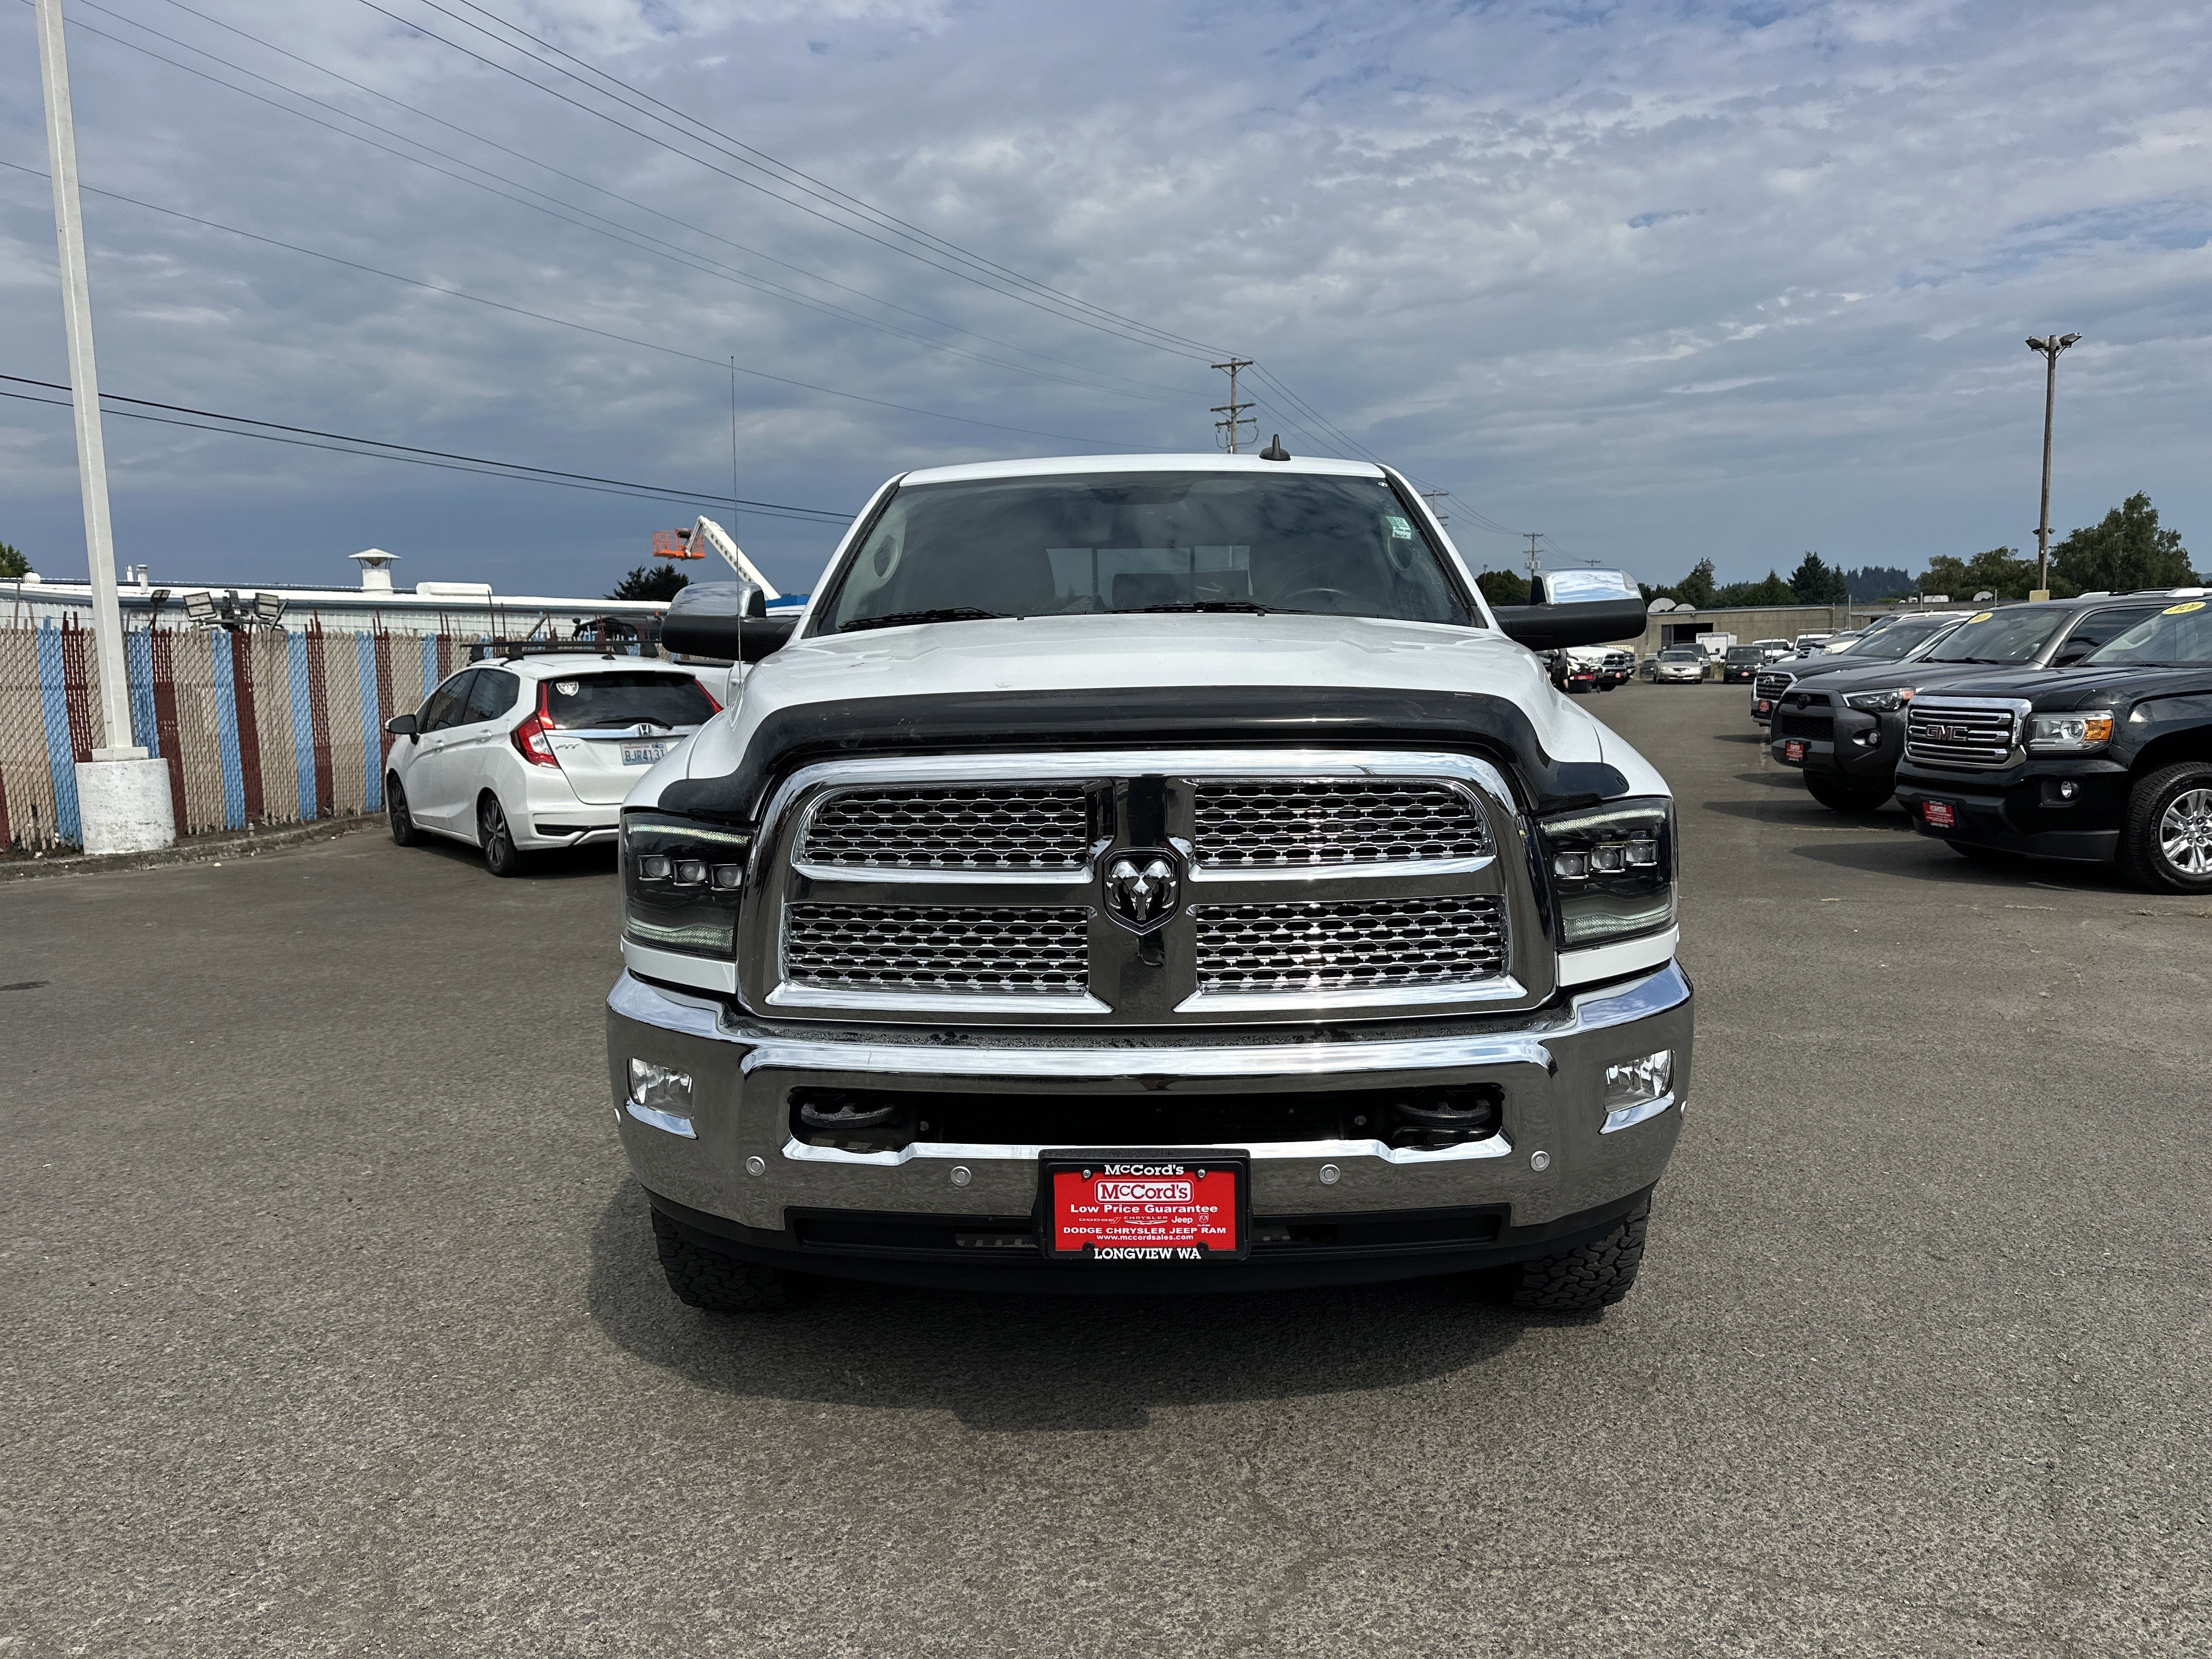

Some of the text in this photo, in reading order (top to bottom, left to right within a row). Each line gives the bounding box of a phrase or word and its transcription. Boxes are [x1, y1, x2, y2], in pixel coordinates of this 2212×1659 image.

[1926, 724, 1968, 742] GMC
[624, 749, 664, 762] BJR4131
[1104, 1164, 1184, 1175] McCord's
[1101, 1184, 1188, 1199] McCord's
[1070, 1204, 1218, 1213] Low Price Guarantee
[1171, 1215, 1193, 1224] Jeep
[1094, 1248, 1201, 1259] LONGVIEW WA
